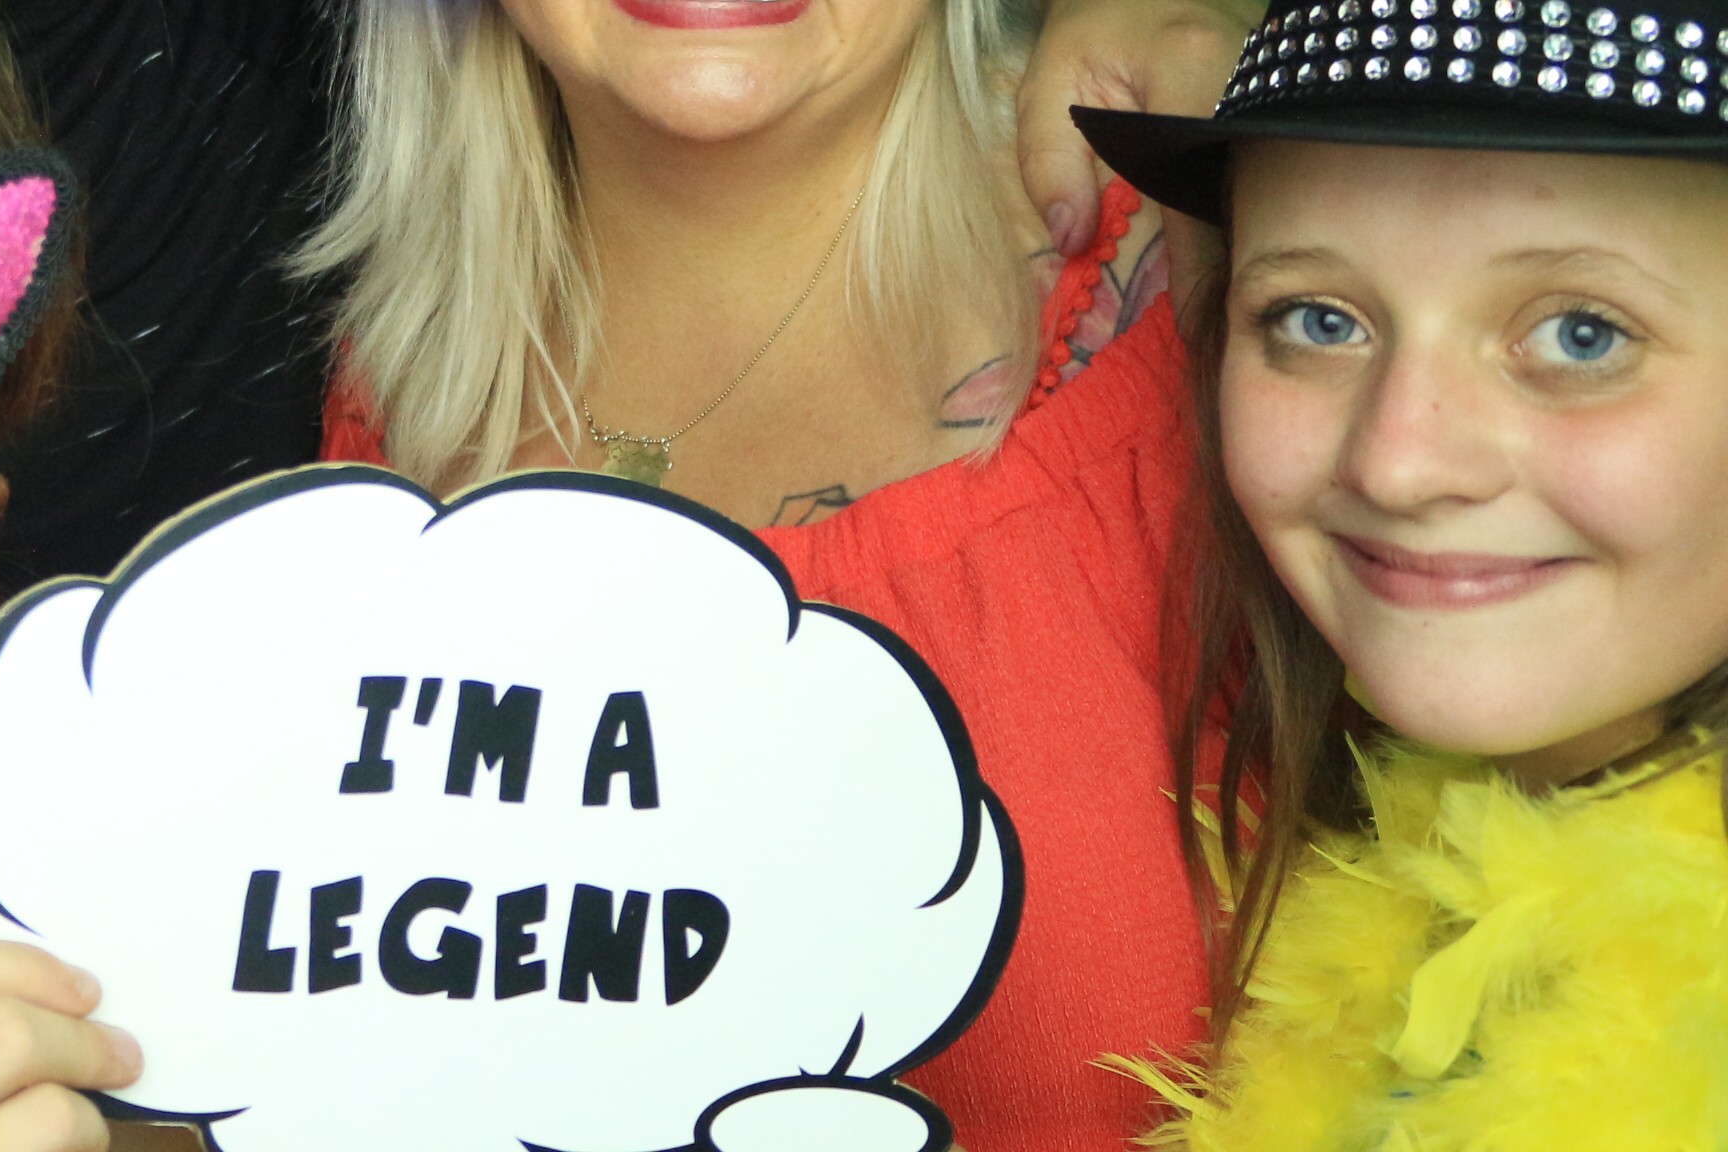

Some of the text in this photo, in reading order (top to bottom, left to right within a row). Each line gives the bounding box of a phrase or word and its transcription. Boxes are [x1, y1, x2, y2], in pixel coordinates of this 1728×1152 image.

[338, 676, 660, 810] I'M A
[232, 869, 731, 1006] LEGEND
